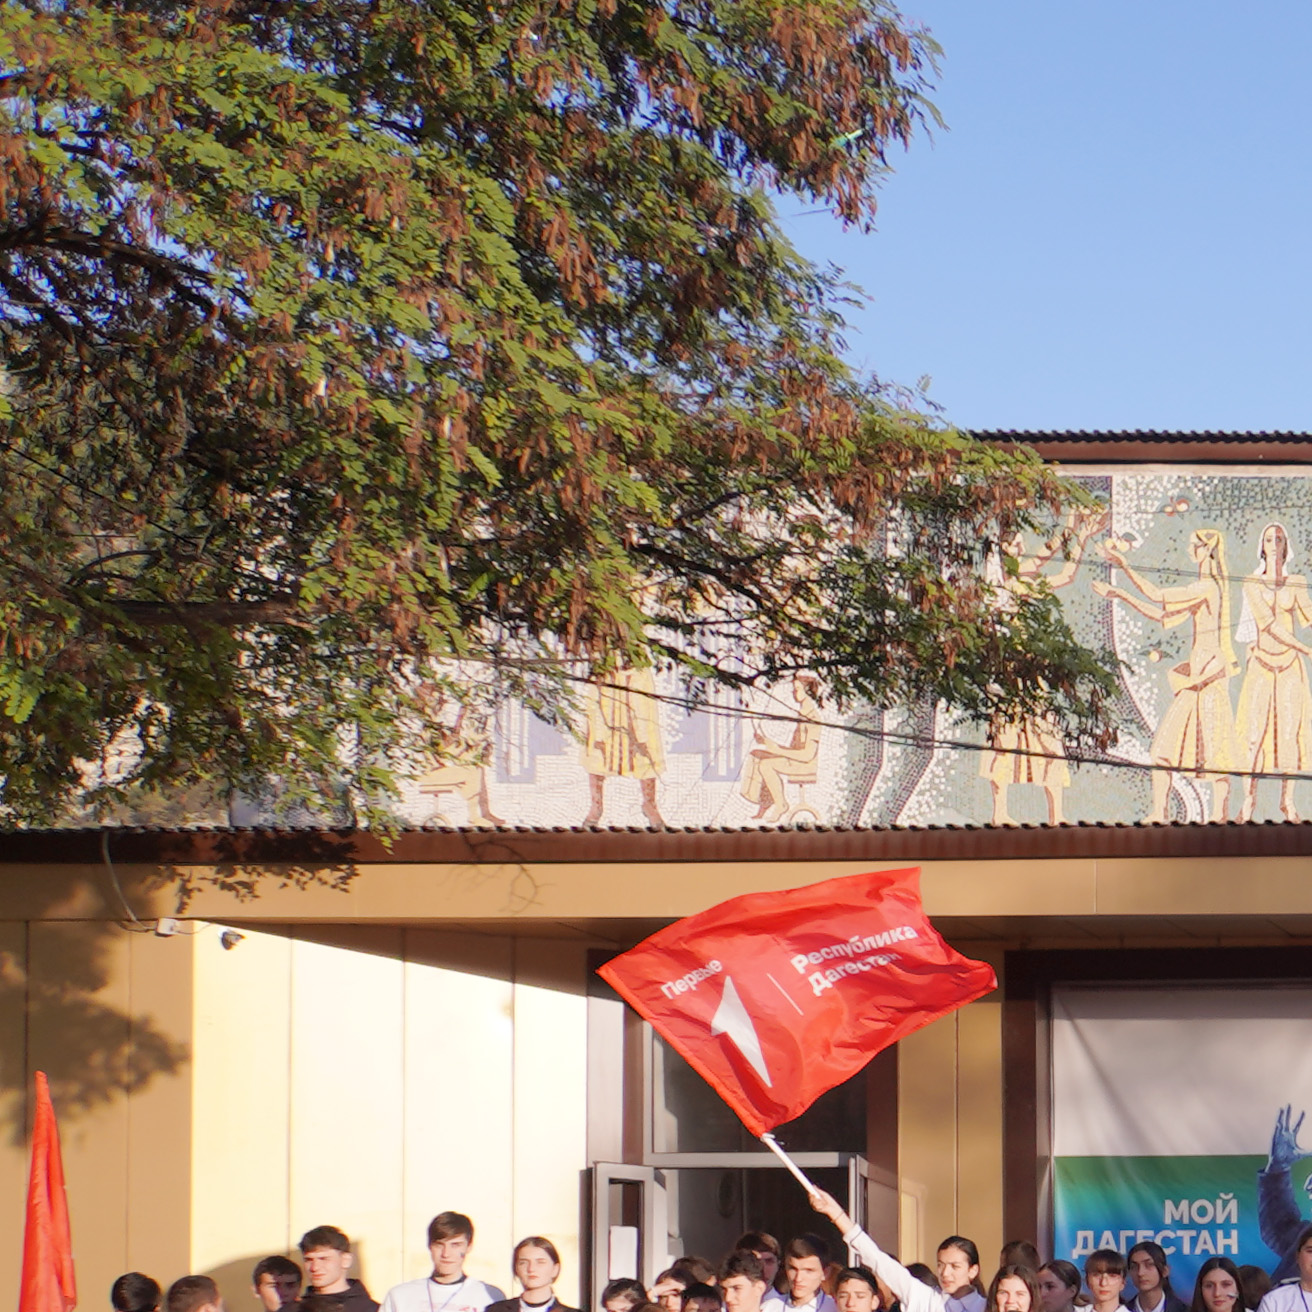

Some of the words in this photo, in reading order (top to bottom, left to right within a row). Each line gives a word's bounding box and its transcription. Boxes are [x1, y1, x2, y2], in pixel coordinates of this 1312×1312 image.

[790, 925, 918, 974] Республика
[660, 959, 724, 1000] Первые
[1164, 1193, 1239, 1224] МОЙ
[1072, 1229, 1239, 1259] ДАГЕСТАН
